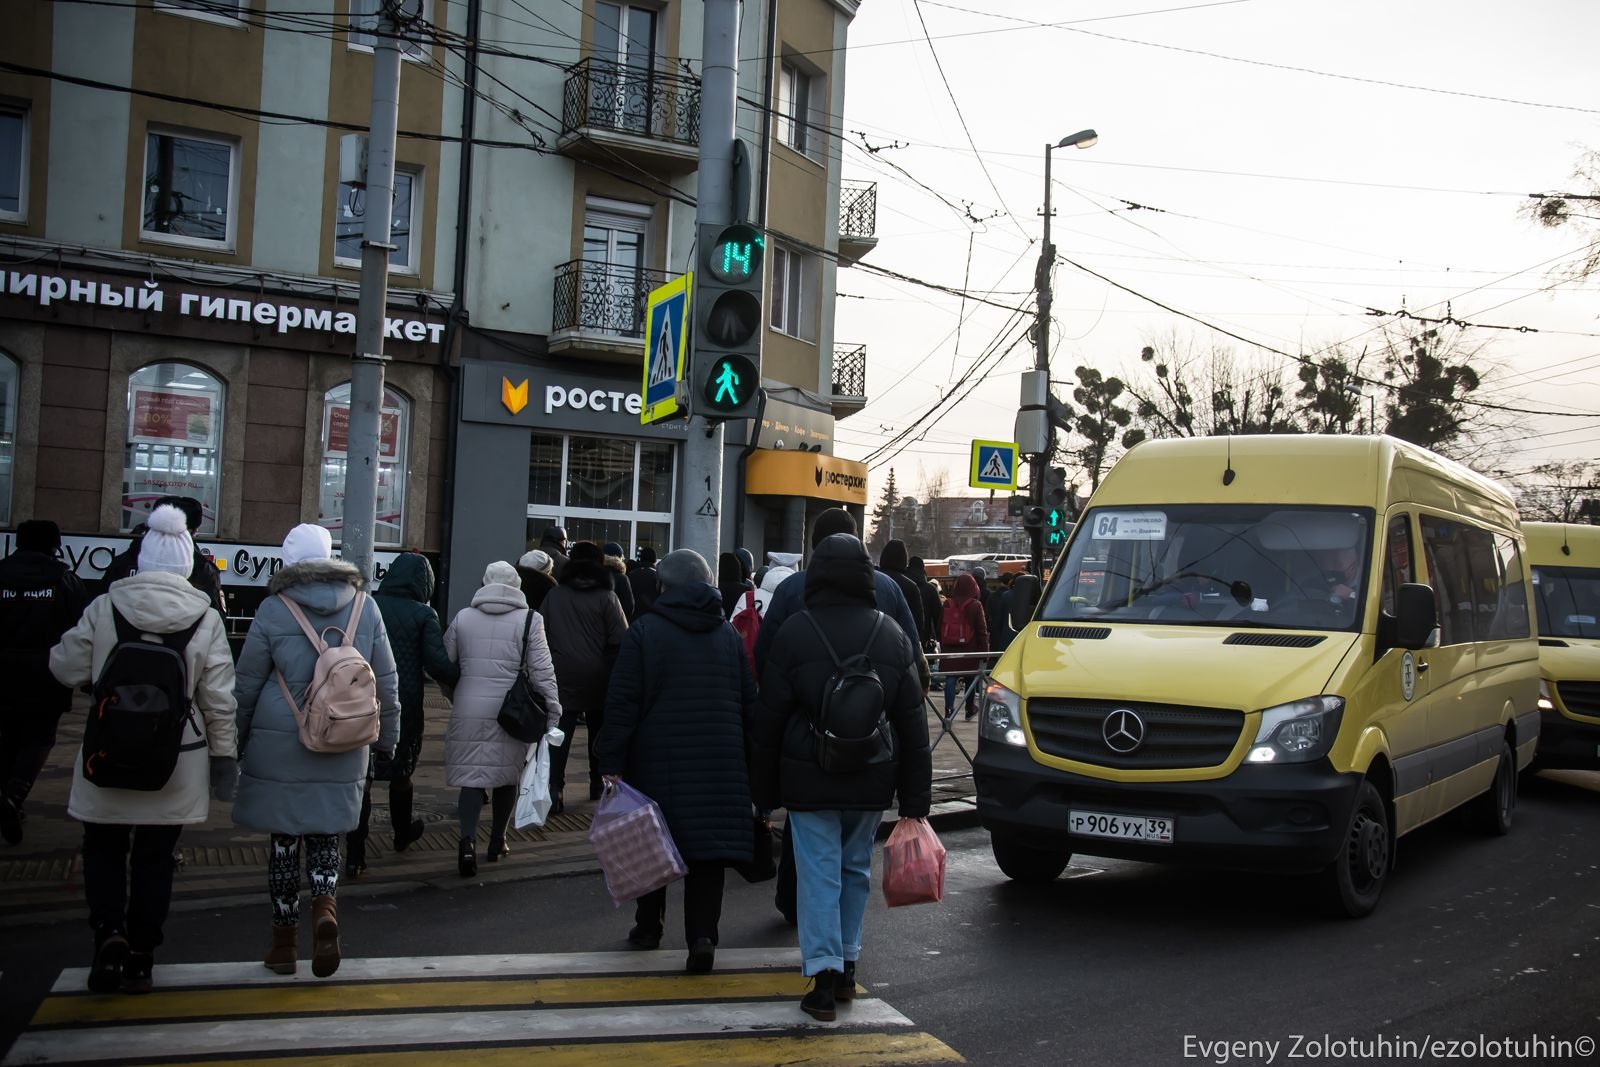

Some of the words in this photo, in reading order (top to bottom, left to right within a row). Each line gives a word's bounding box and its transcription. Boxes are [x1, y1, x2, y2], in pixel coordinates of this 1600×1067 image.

[723, 242, 751, 275] 14
[180, 293, 446, 344] гипермакет
[544, 385, 642, 415] росте
[704, 475, 711, 492] 1
[1098, 516, 1118, 536] 64
[1050, 532, 1061, 544] 14
[3, 588, 53, 600] ПОИЦИЯ
[1148, 819, 1167, 834] 39
